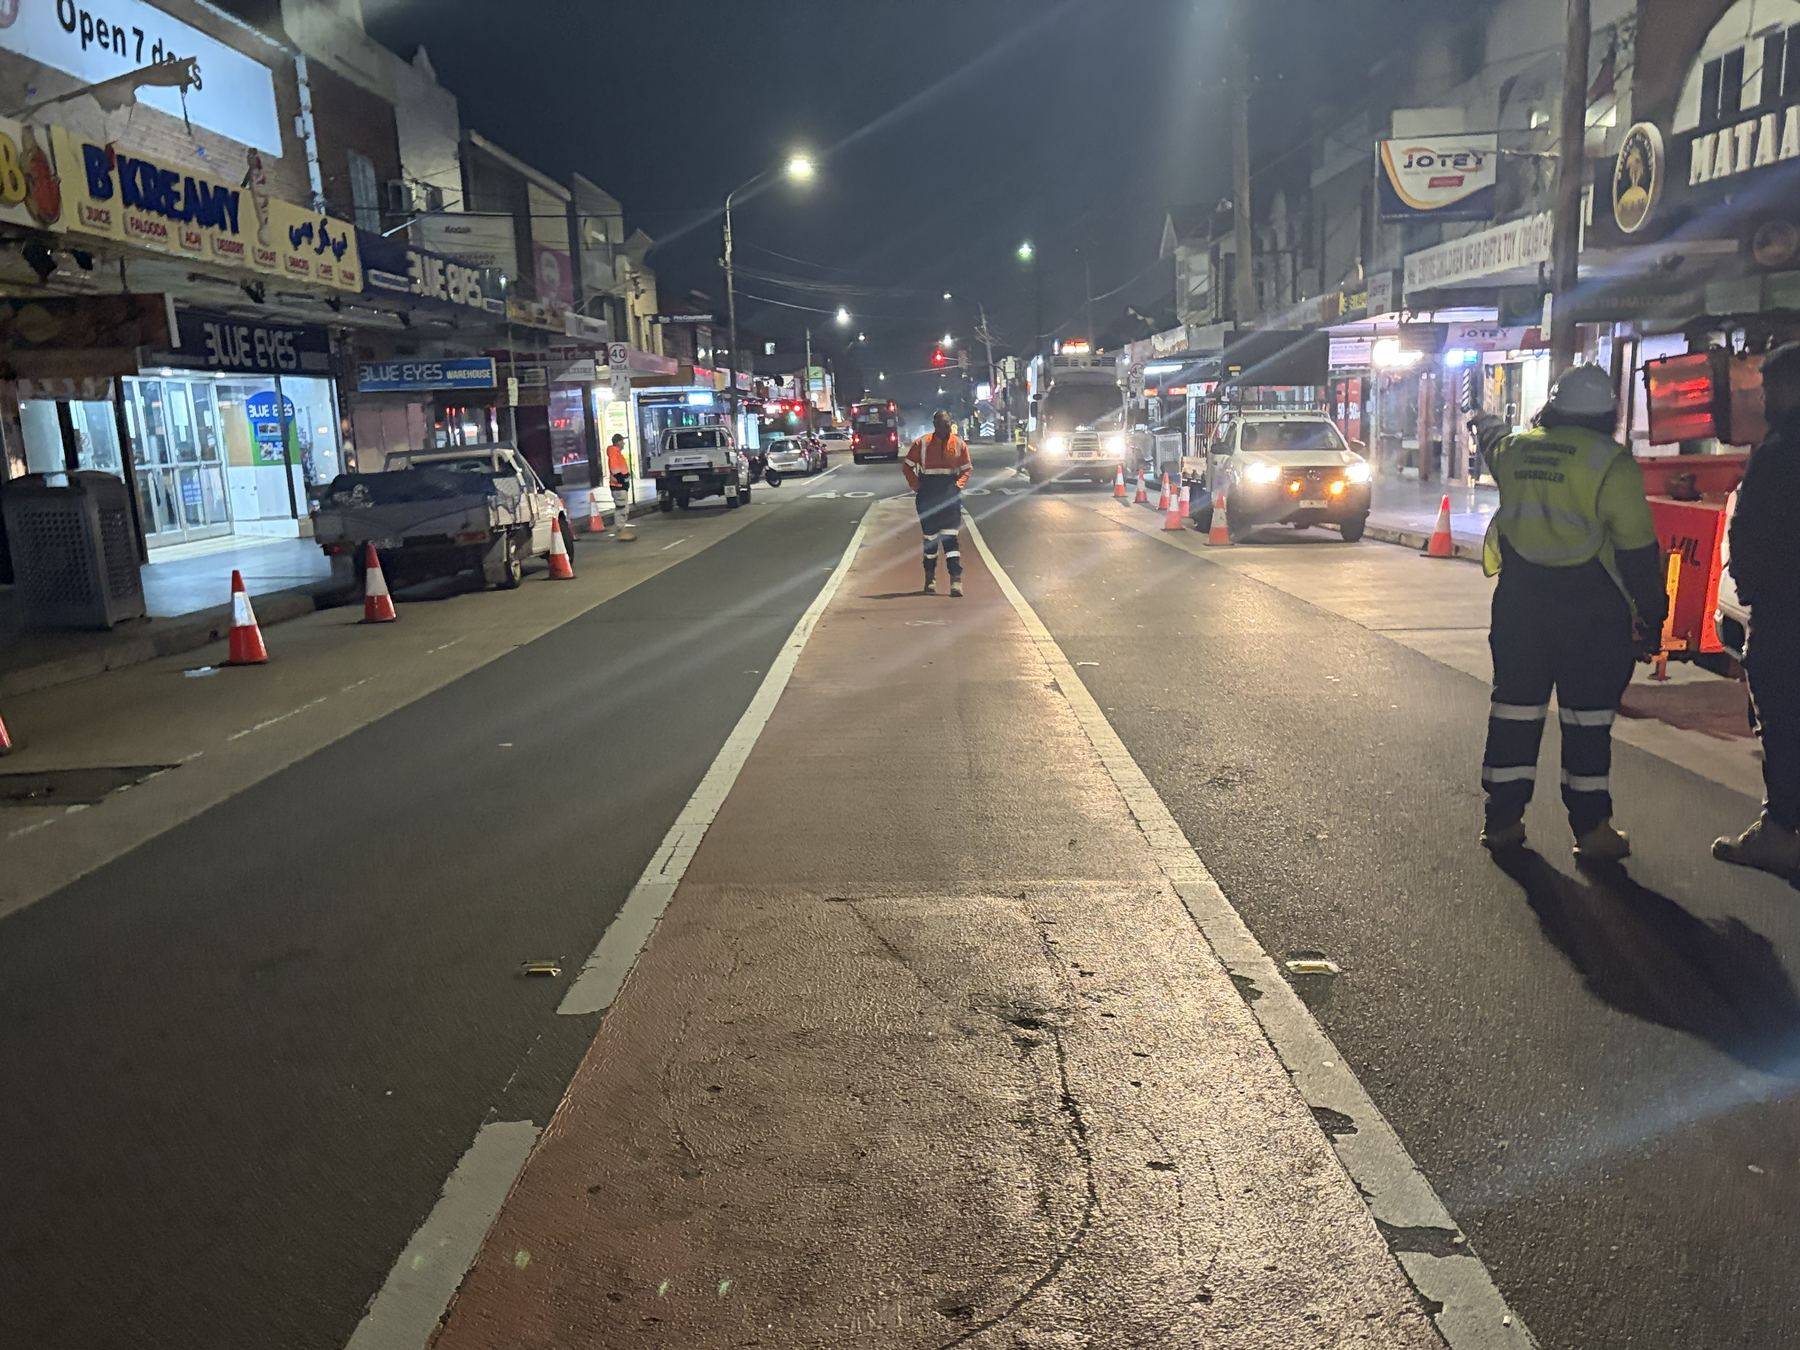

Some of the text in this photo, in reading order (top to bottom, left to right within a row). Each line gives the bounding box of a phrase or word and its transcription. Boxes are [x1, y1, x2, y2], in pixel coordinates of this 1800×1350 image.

[57, 0, 127, 57] Open
[132, 26, 144, 64] 7
[1403, 149, 1485, 169] JOTEY
[203, 322, 297, 370] BLUE EYES
[611, 349, 626, 359] 40
[359, 364, 491, 382] BLUE EYES WAREHOUSE
[248, 403, 293, 418] BLUE EES
[806, 490, 876, 499] 40
